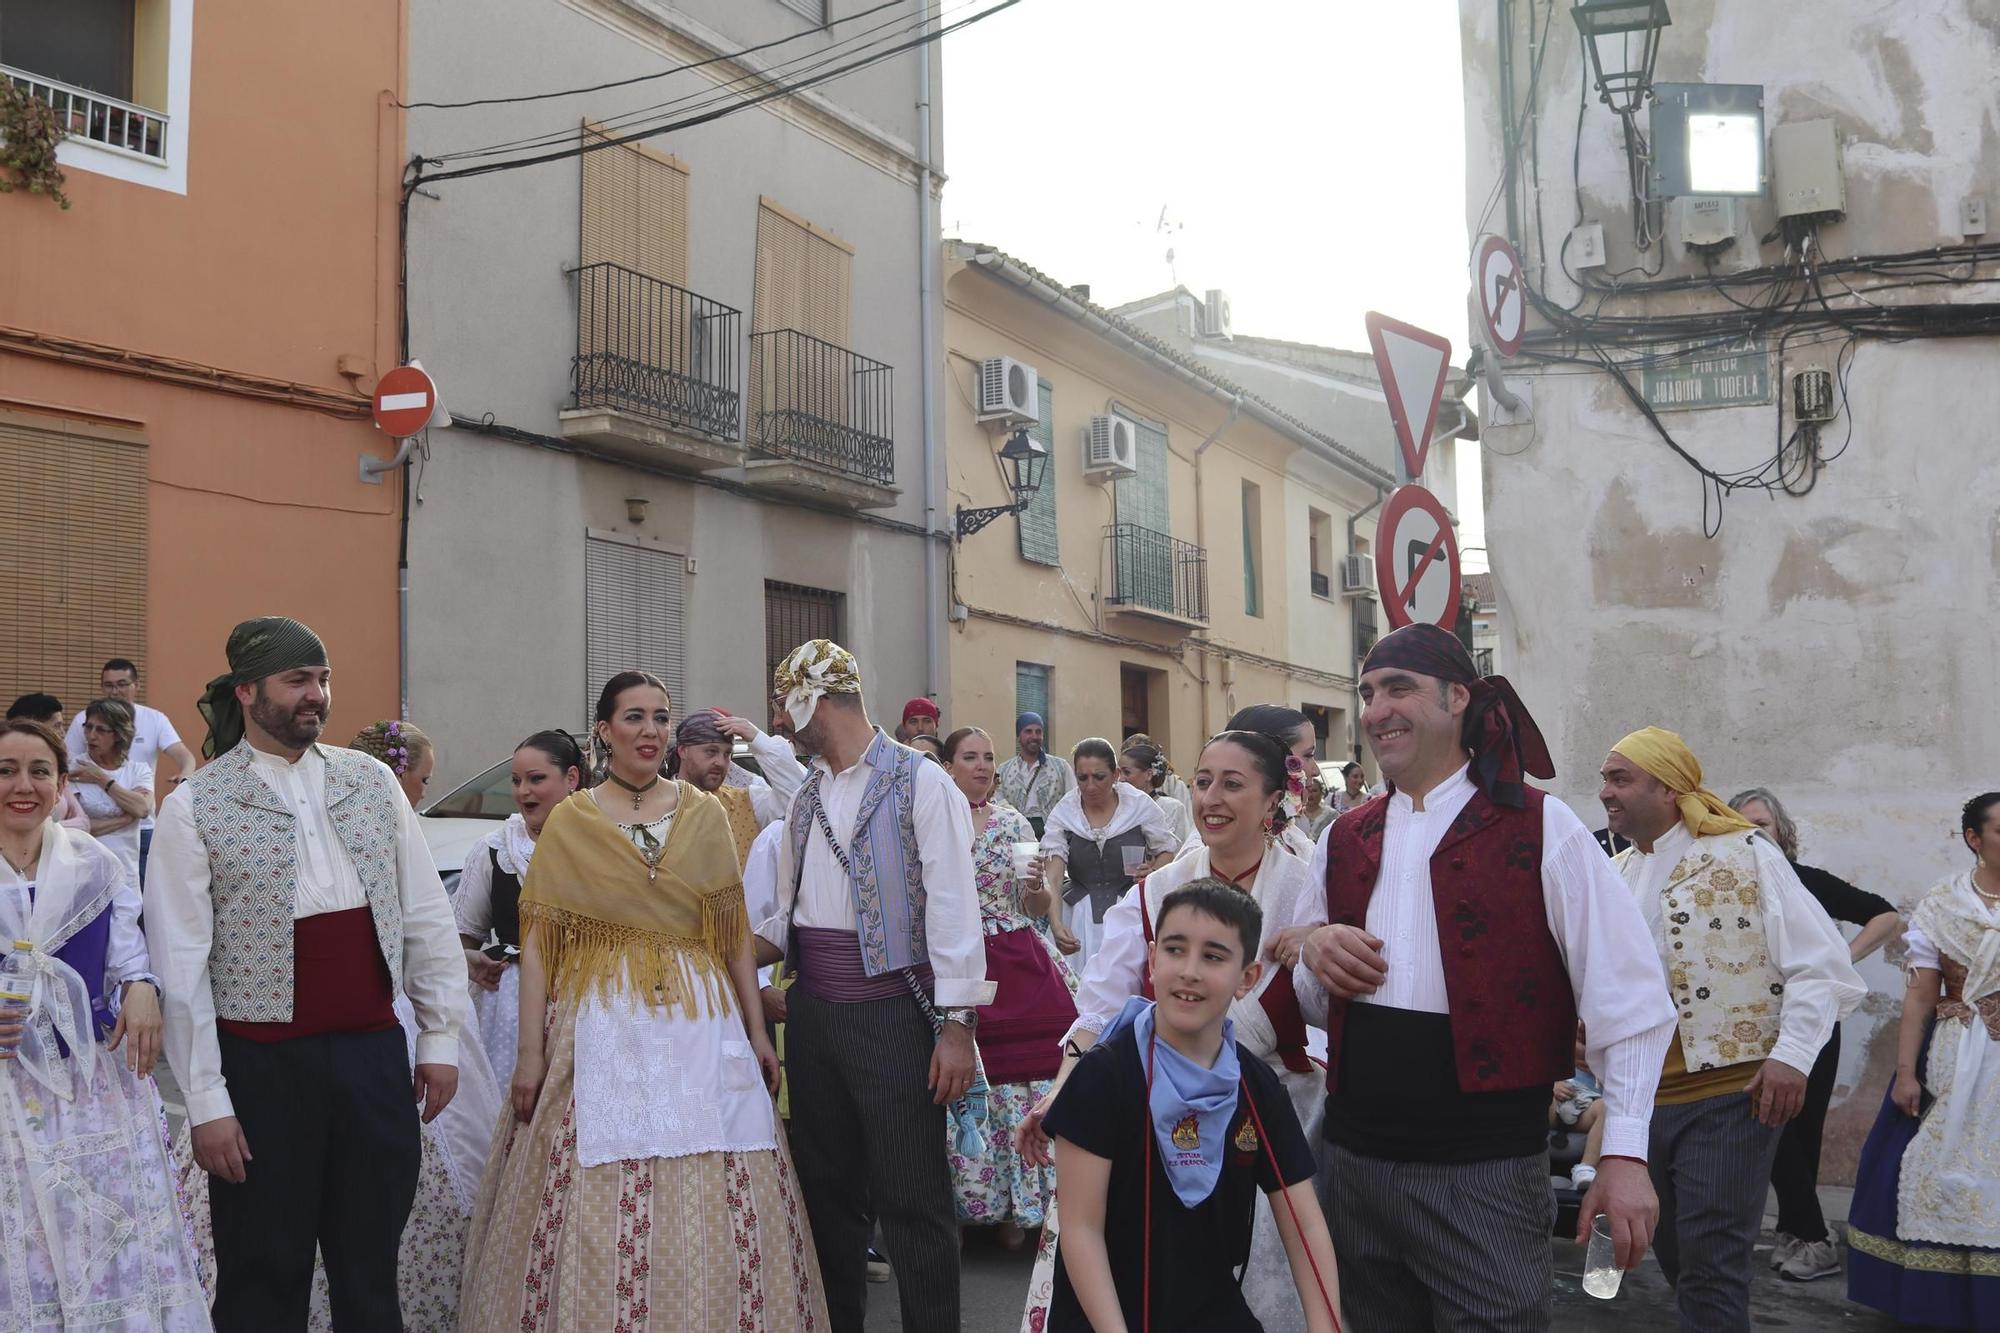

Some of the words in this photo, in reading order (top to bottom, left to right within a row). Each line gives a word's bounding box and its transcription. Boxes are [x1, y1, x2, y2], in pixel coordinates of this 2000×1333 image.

[1692, 358, 1737, 374] PINTOR
[1653, 378, 1702, 403] JOAQUIN
[1713, 375, 1759, 398] TUDELA
